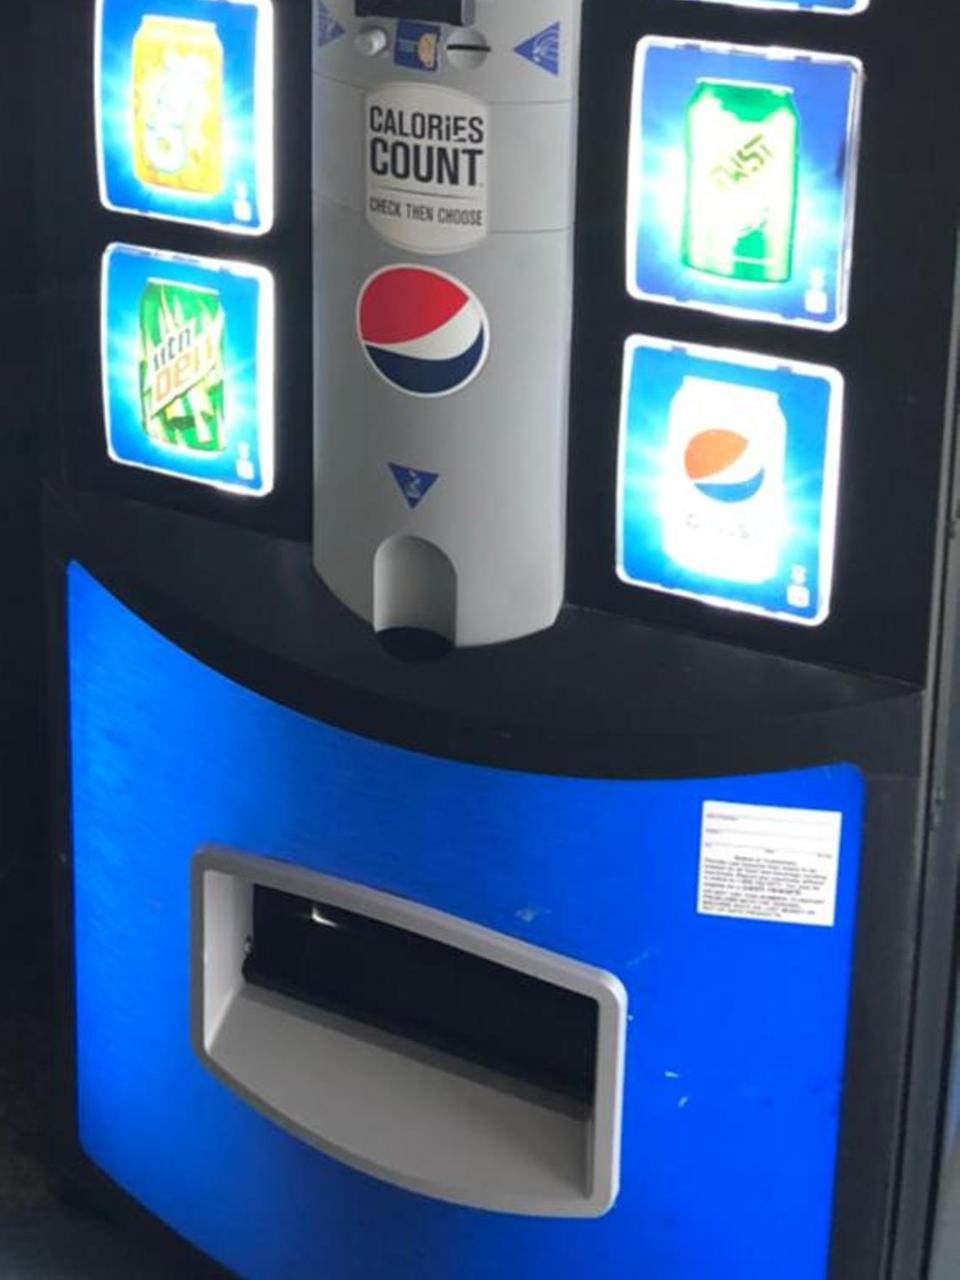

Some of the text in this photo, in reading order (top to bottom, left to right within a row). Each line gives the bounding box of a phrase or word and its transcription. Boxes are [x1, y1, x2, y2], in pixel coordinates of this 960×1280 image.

[370, 136, 483, 186] COUNT
[369, 196, 483, 226] CHECK THEN CHOOSE
